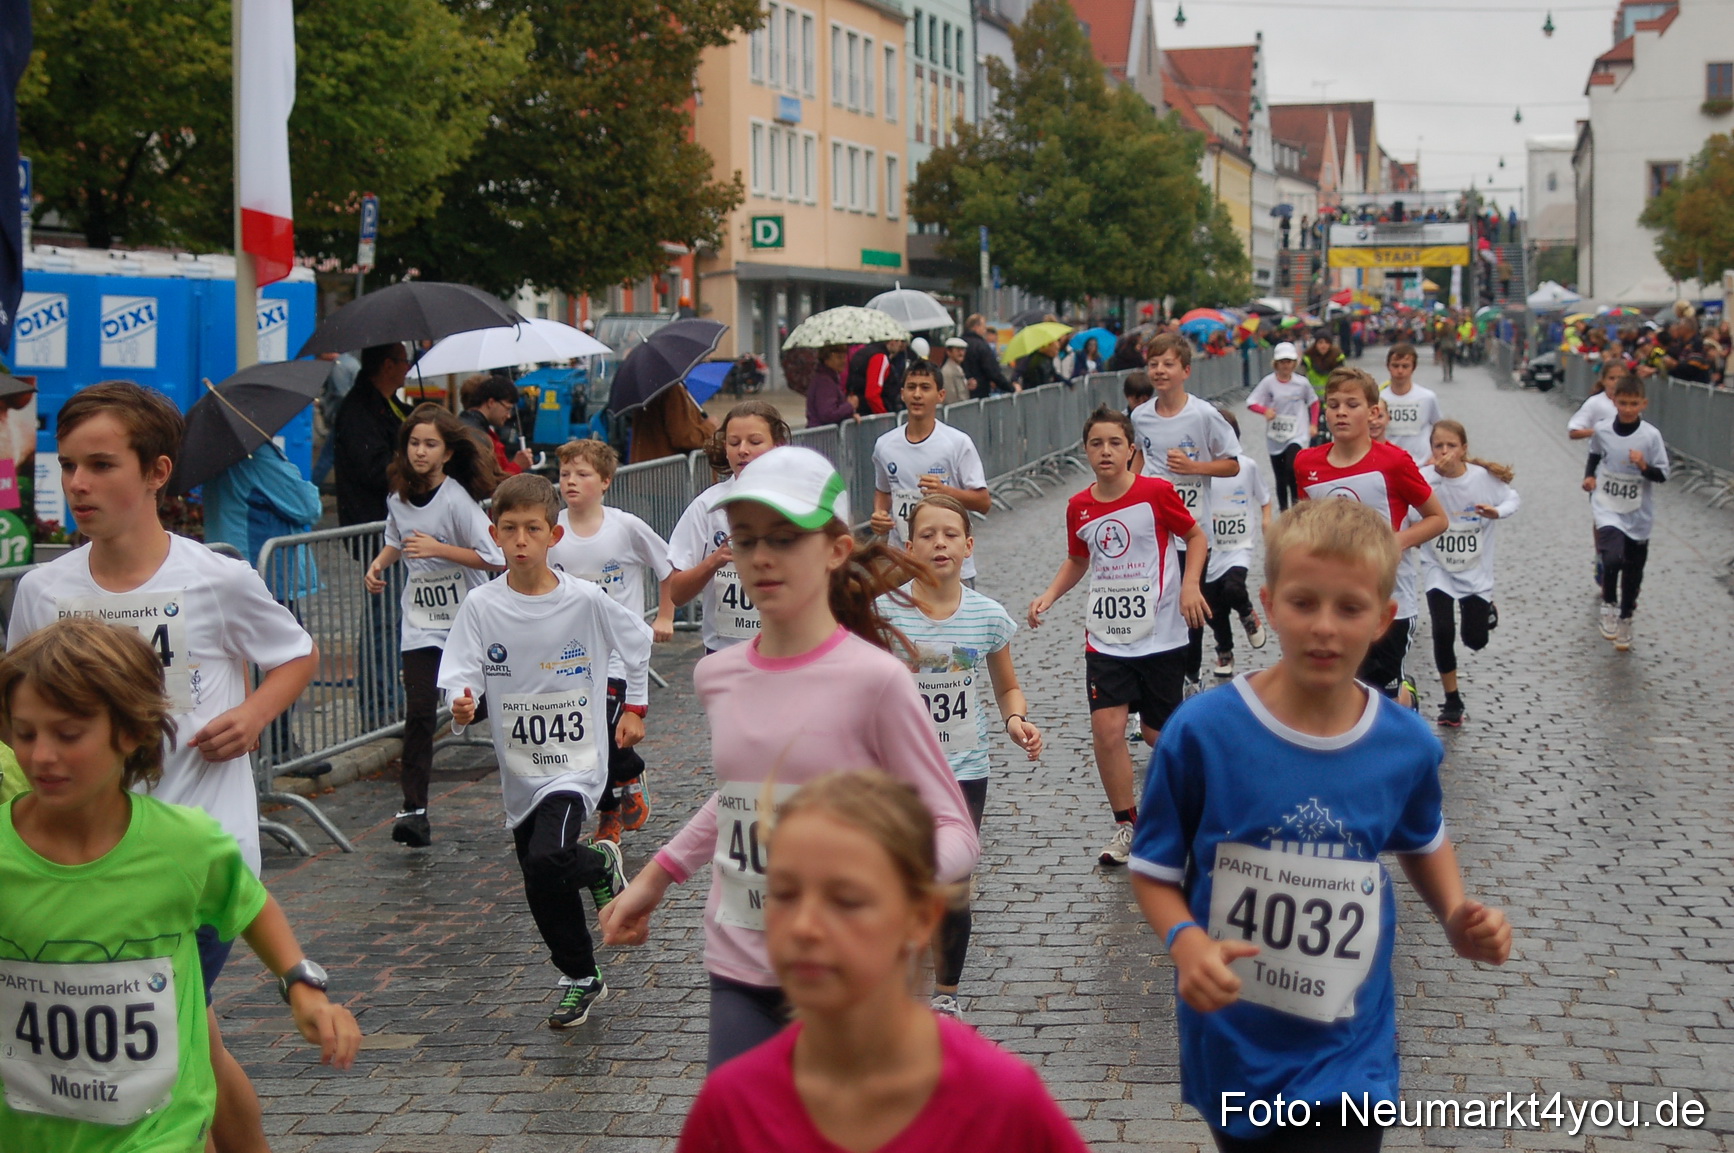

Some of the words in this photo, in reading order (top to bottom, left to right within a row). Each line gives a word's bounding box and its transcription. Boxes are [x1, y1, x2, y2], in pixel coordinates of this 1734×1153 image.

[755, 220, 779, 245] D
[1374, 251, 1421, 263] START
[17, 301, 65, 336] DIXI
[102, 304, 154, 338] DIXI
[1603, 481, 1638, 499] 4048
[1436, 535, 1477, 552] 4009
[414, 583, 460, 608] 4001
[99, 607, 159, 620] Neumarkt
[1093, 595, 1147, 620] 4033
[429, 613, 451, 622] Linda
[1106, 626, 1132, 635] Jonas
[486, 665, 511, 673] PARTL
[918, 681, 961, 690] Neumarkt
[503, 702, 531, 712] PARTL
[533, 700, 576, 711] Neumarkt
[512, 711, 585, 746] 4043
[532, 752, 569, 766] Simon
[717, 795, 751, 811] PARTL
[1218, 857, 1273, 881] PARTL
[1278, 869, 1355, 895] Neumarkt
[1226, 886, 1365, 960] 4032
[1253, 959, 1326, 997] Tobias
[54, 979, 141, 996] Neumarkt
[15, 1001, 159, 1063] 4005
[51, 1073, 119, 1102] Moritz
